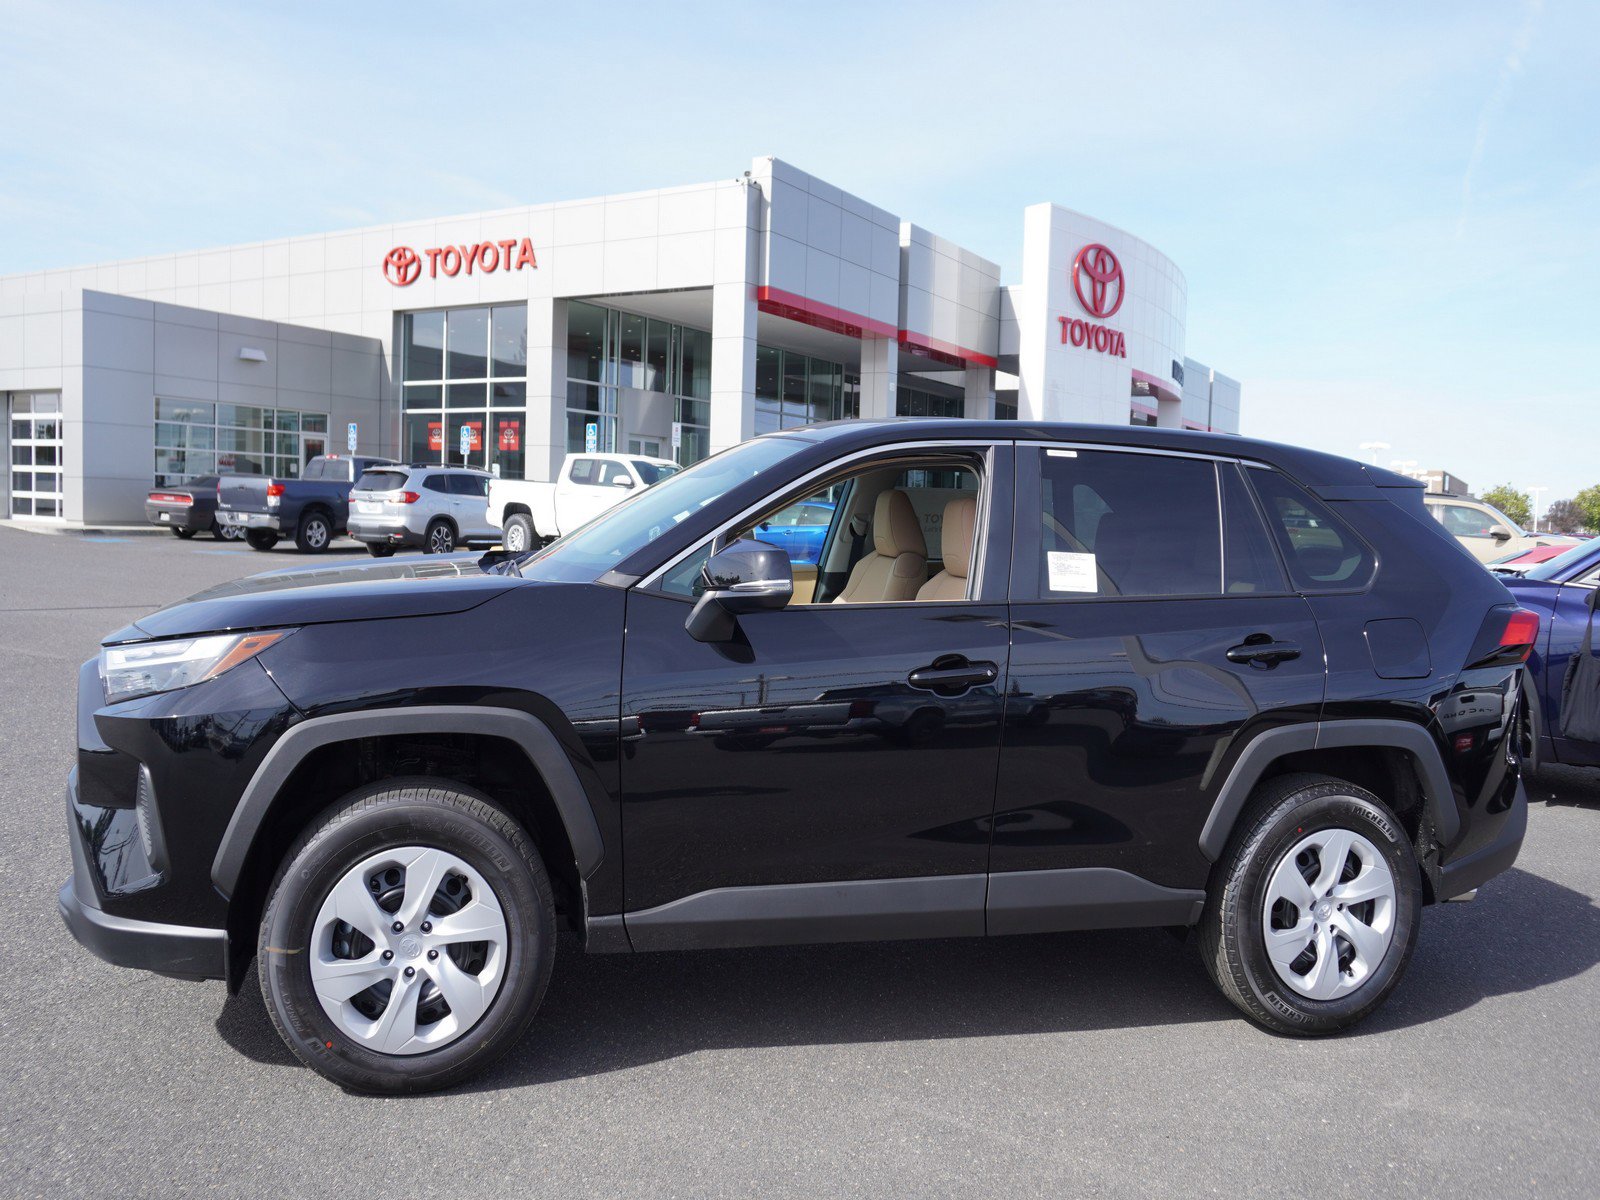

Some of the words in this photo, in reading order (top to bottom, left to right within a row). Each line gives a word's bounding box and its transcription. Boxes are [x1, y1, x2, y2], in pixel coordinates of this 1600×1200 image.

[424, 237, 537, 278] TOYOTA
[1058, 316, 1126, 358] TOYOTA
[1352, 805, 1395, 840] MICHELIN
